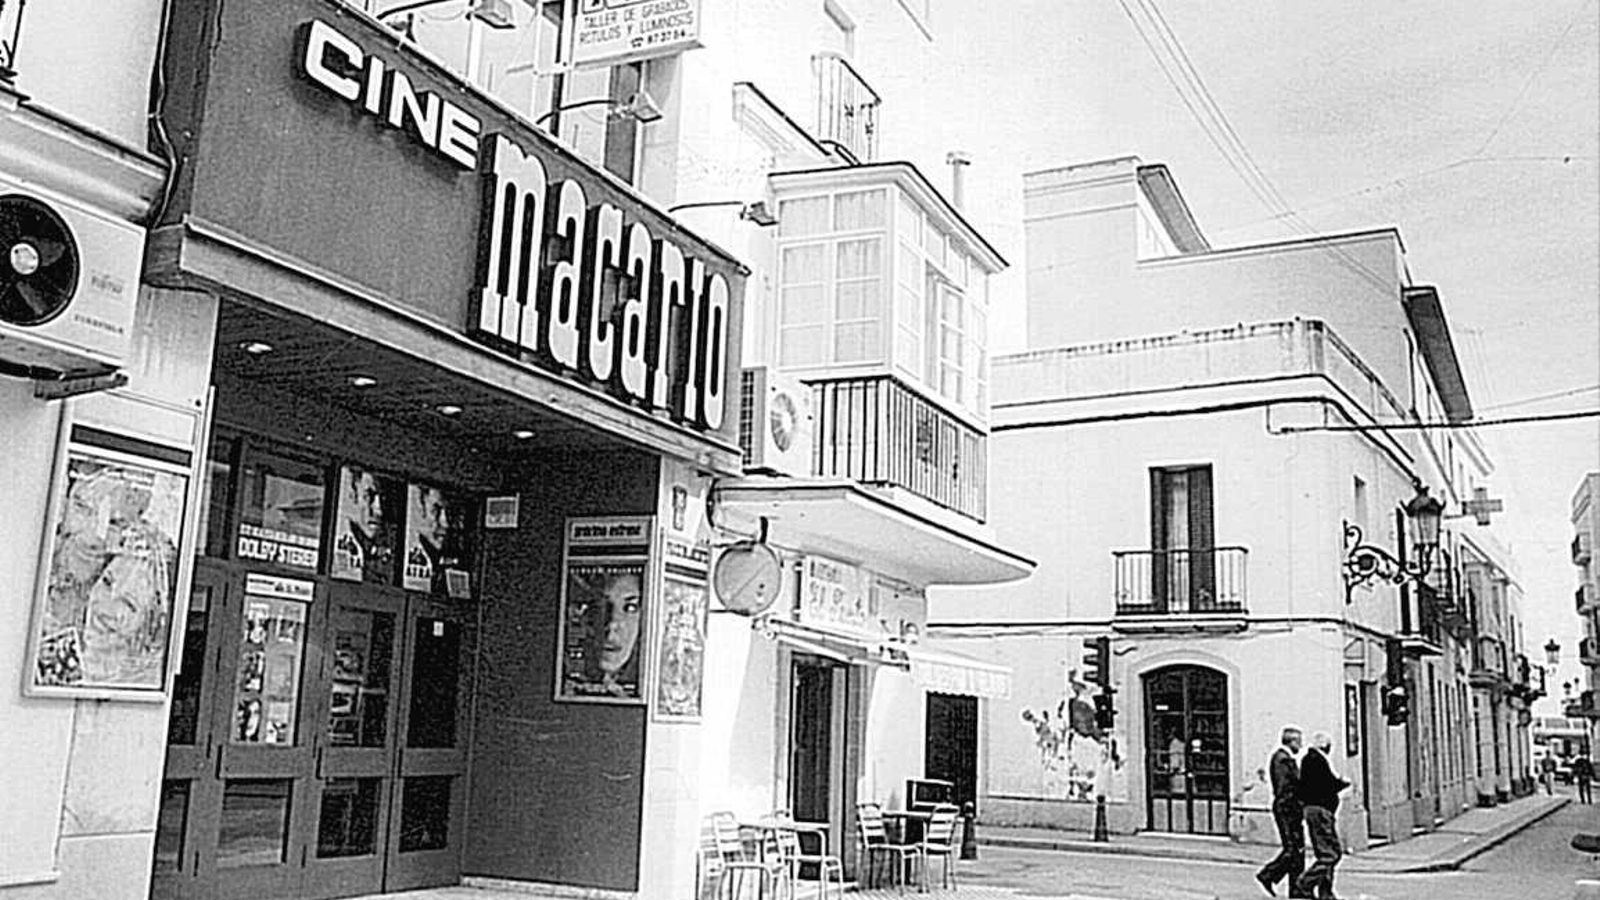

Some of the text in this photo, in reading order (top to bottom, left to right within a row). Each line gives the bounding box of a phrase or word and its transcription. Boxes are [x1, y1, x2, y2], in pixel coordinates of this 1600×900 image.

[583, 10, 618, 28] TALLER
[623, 8, 635, 22] DE
[304, 18, 480, 171] CINE
[238, 537, 277, 562] DOLBY
